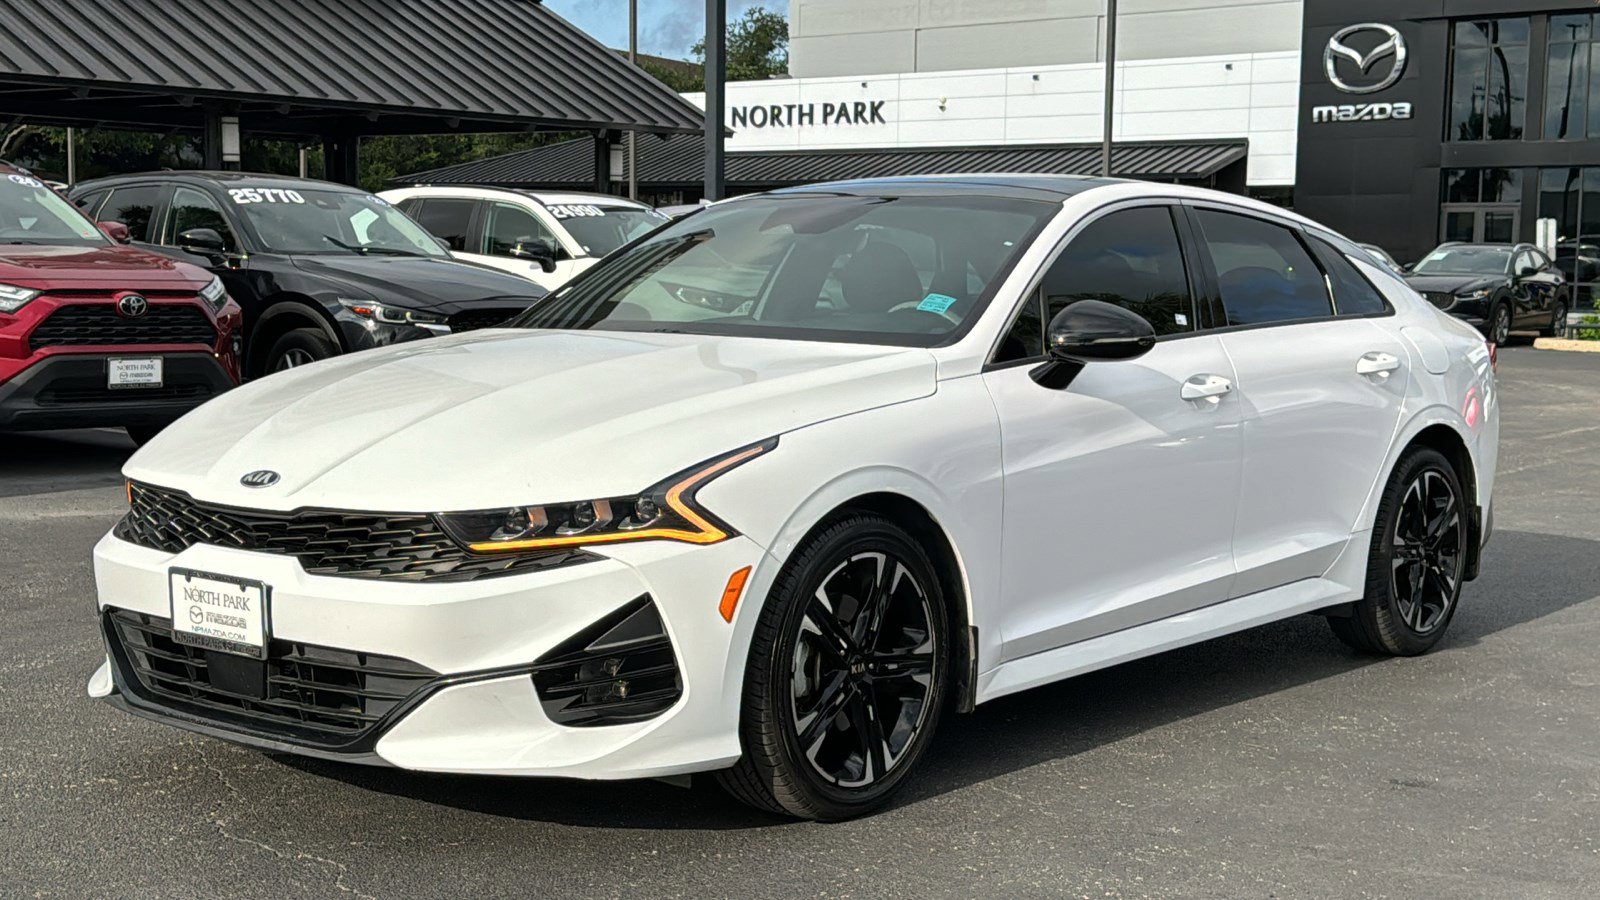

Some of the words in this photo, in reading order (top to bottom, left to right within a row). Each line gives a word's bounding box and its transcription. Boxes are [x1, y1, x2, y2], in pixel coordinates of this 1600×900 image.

[731, 104, 814, 128] NORTH
[822, 100, 886, 126] PARK
[1312, 102, 1412, 123] mazda
[228, 188, 305, 204] 25770
[546, 204, 606, 219] 24990
[243, 472, 273, 484] KIA
[184, 586, 220, 607] NORTH
[223, 594, 250, 612] PARK
[851, 662, 866, 674] KIA
